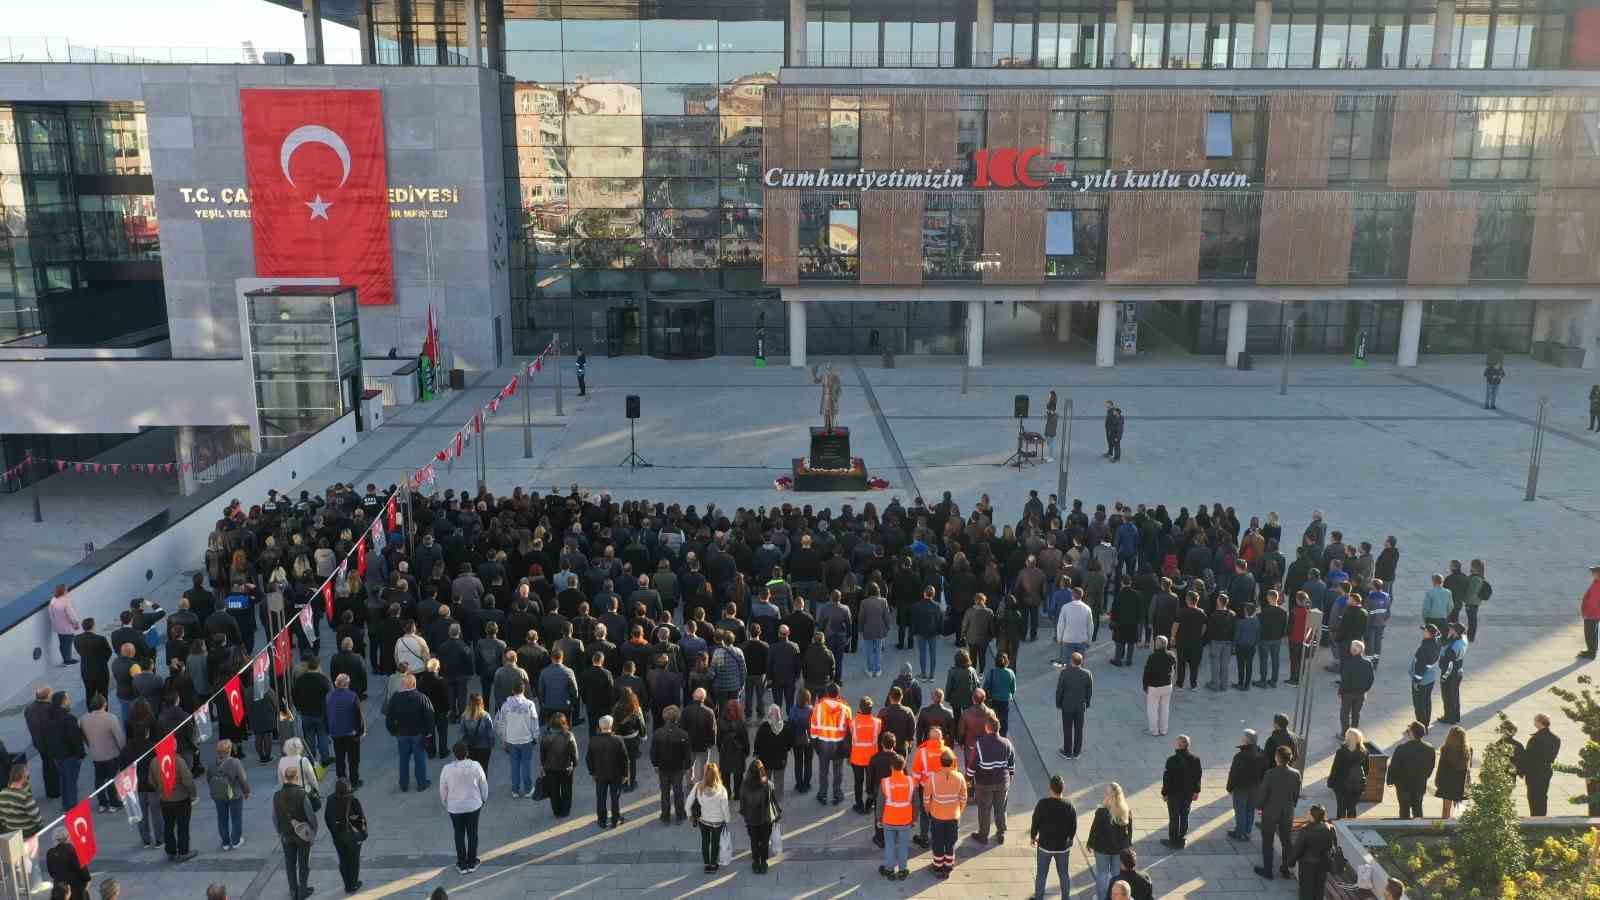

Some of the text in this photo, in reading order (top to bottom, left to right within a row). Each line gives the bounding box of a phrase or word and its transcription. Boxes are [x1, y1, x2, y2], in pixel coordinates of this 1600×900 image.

[765, 167, 964, 191] Cumhuriyetimizin
[1123, 169, 1181, 188] kutlu
[179, 187, 216, 203] T.C.
[221, 187, 252, 205] ÇA
